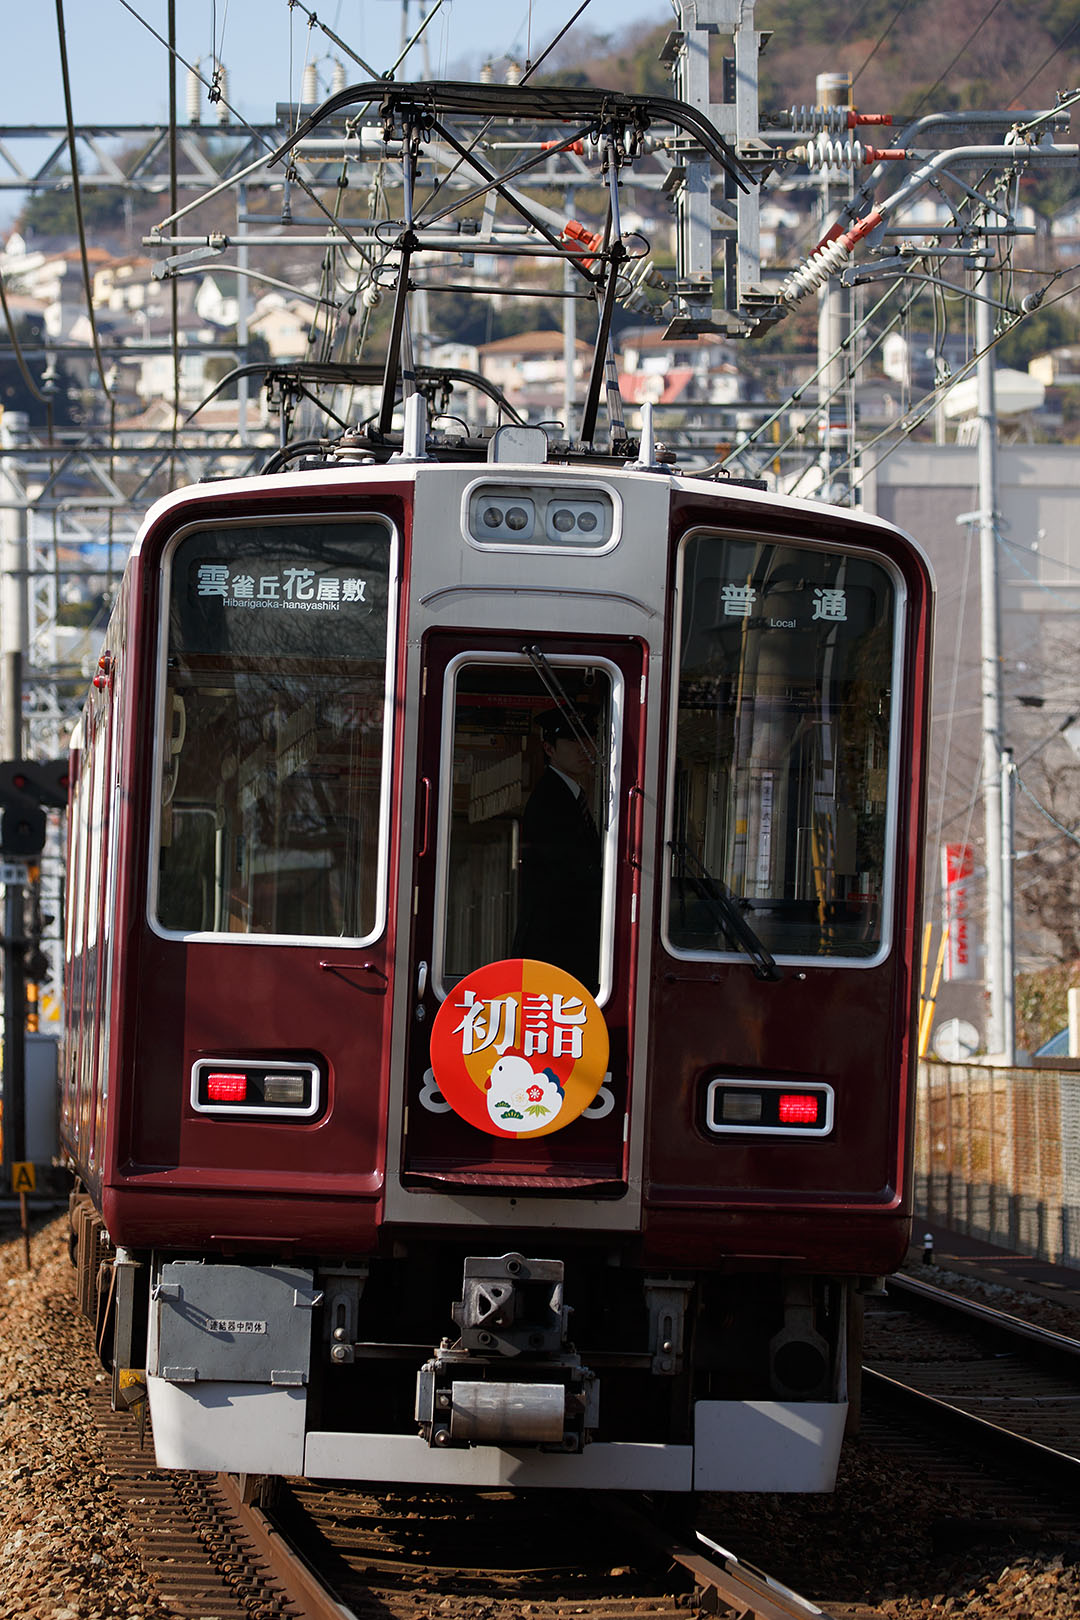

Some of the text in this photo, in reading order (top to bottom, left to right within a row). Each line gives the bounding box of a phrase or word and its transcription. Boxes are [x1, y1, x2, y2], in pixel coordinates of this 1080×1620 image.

[197, 564, 367, 602] 雲雀丘花屋敷
[222, 598, 340, 611] Hibarigaoka-hanayashiki
[770, 618, 797, 628] Local
[452, 989, 588, 1059] 初詣
[15, 1165, 33, 1189] A
